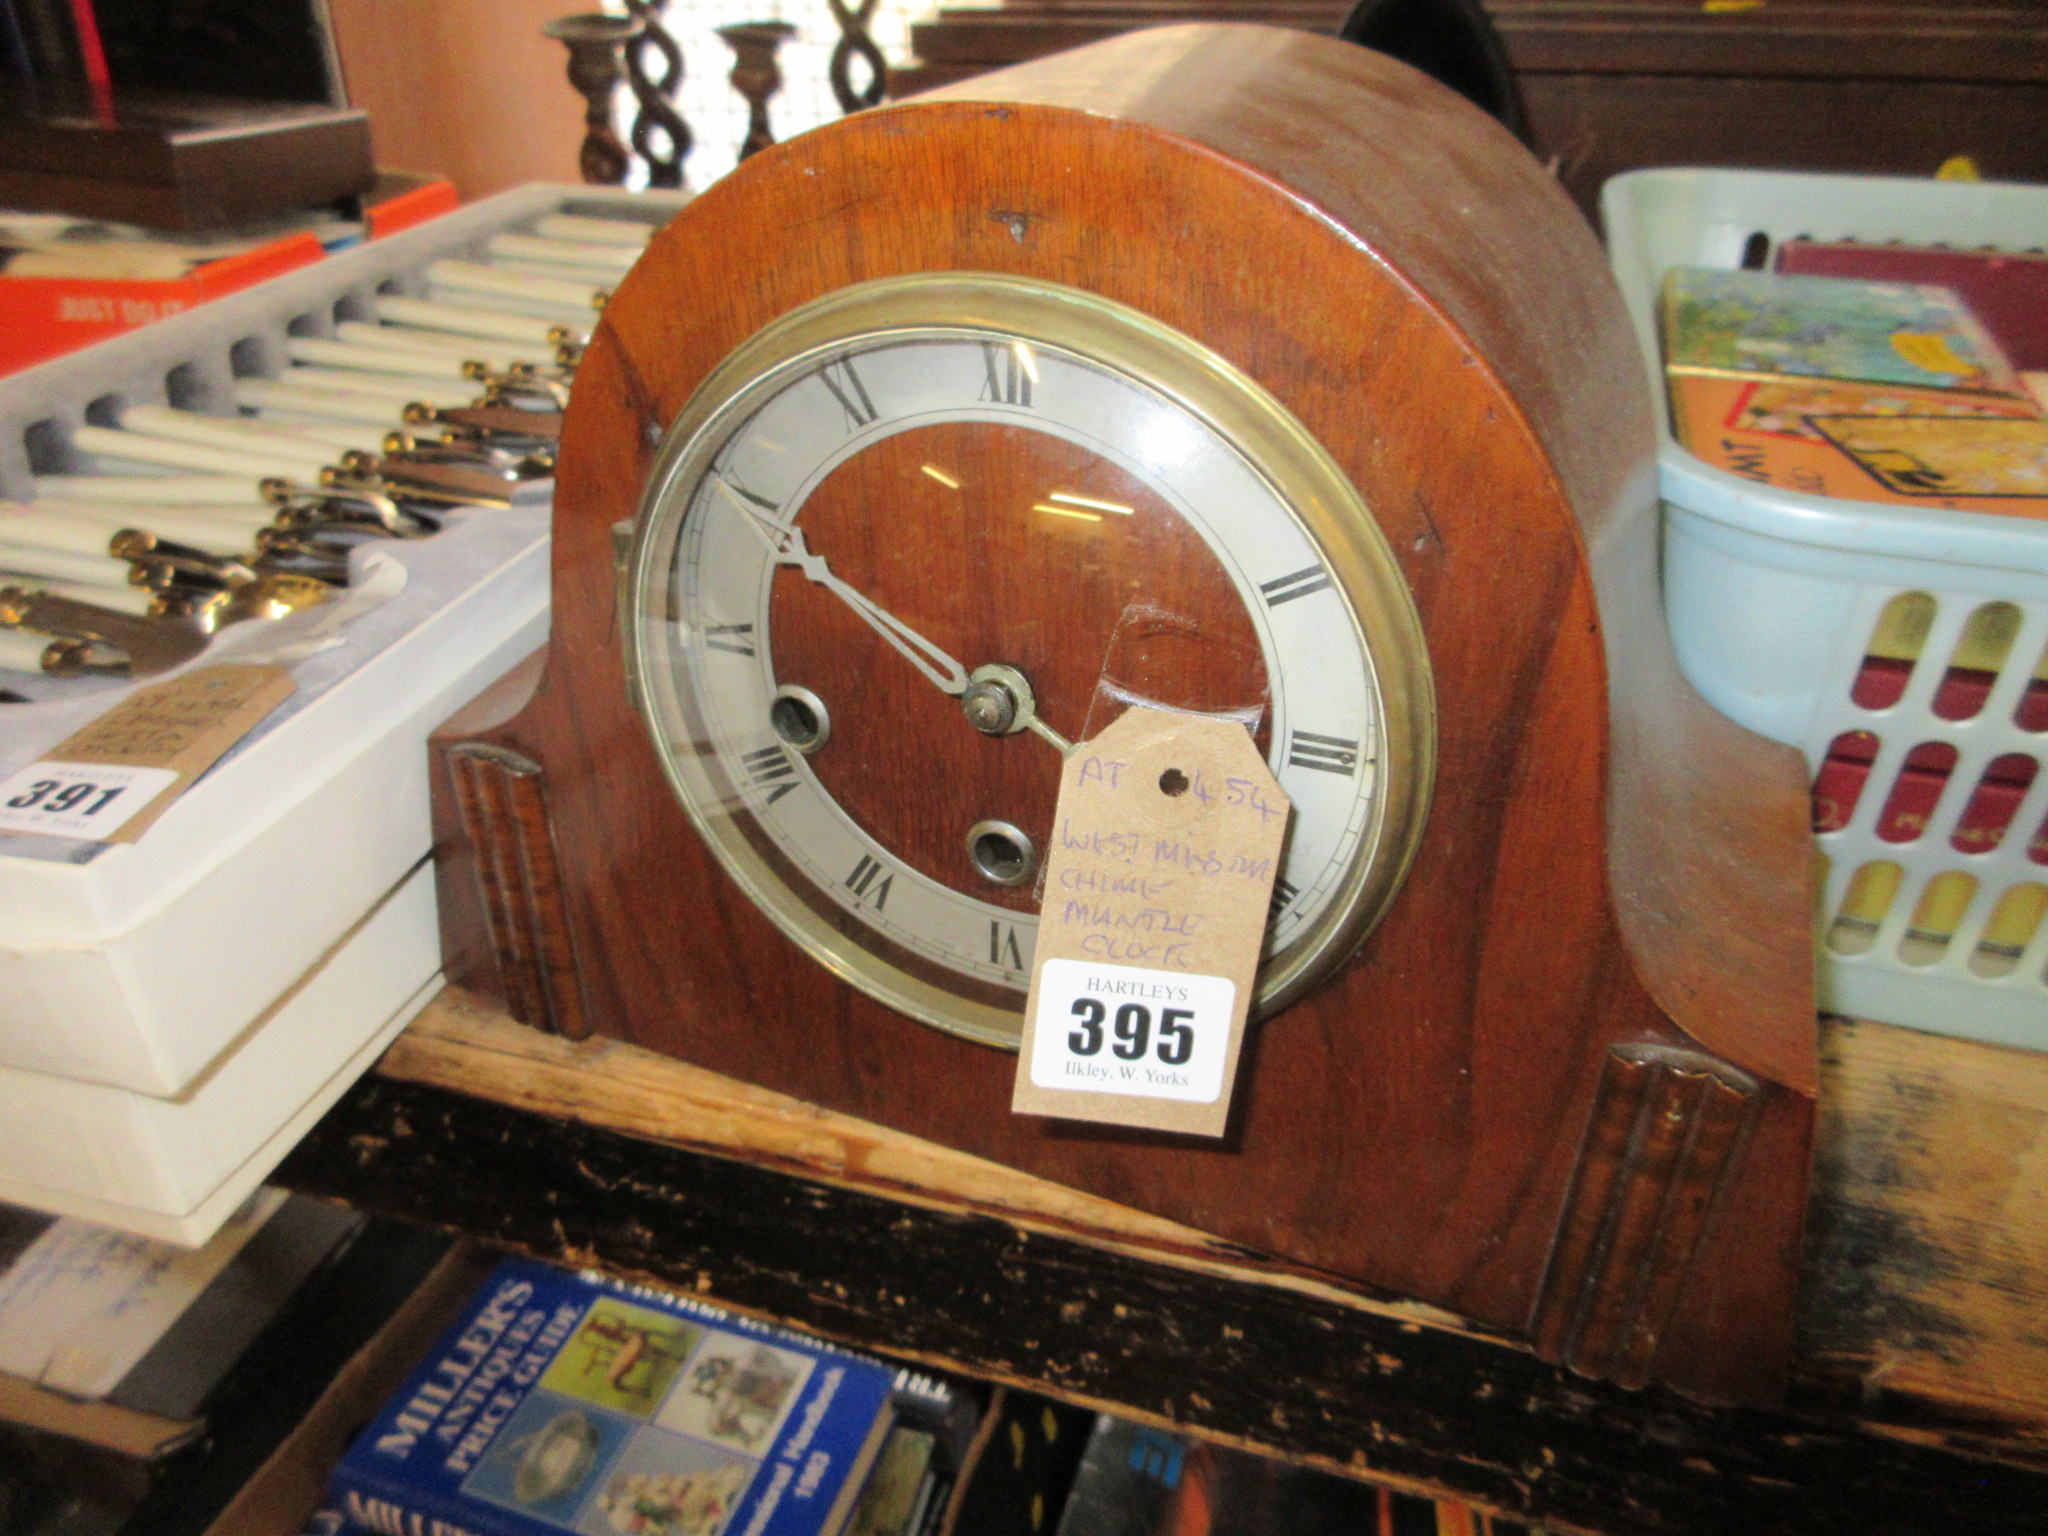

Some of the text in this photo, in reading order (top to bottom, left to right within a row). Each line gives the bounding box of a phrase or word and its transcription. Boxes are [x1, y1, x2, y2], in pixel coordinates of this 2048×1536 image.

[6, 779, 128, 816] 391
[844, 853, 896, 912] VII
[989, 919, 1026, 972] VI
[1086, 976, 1189, 1002] HARTLEYS
[1066, 996, 1196, 1066] 395
[1064, 1060, 1190, 1088] Ilkley, W. Yorks
[437, 1310, 547, 1440] ANTIQUES
[445, 1301, 586, 1472] PRICE GUIDE
